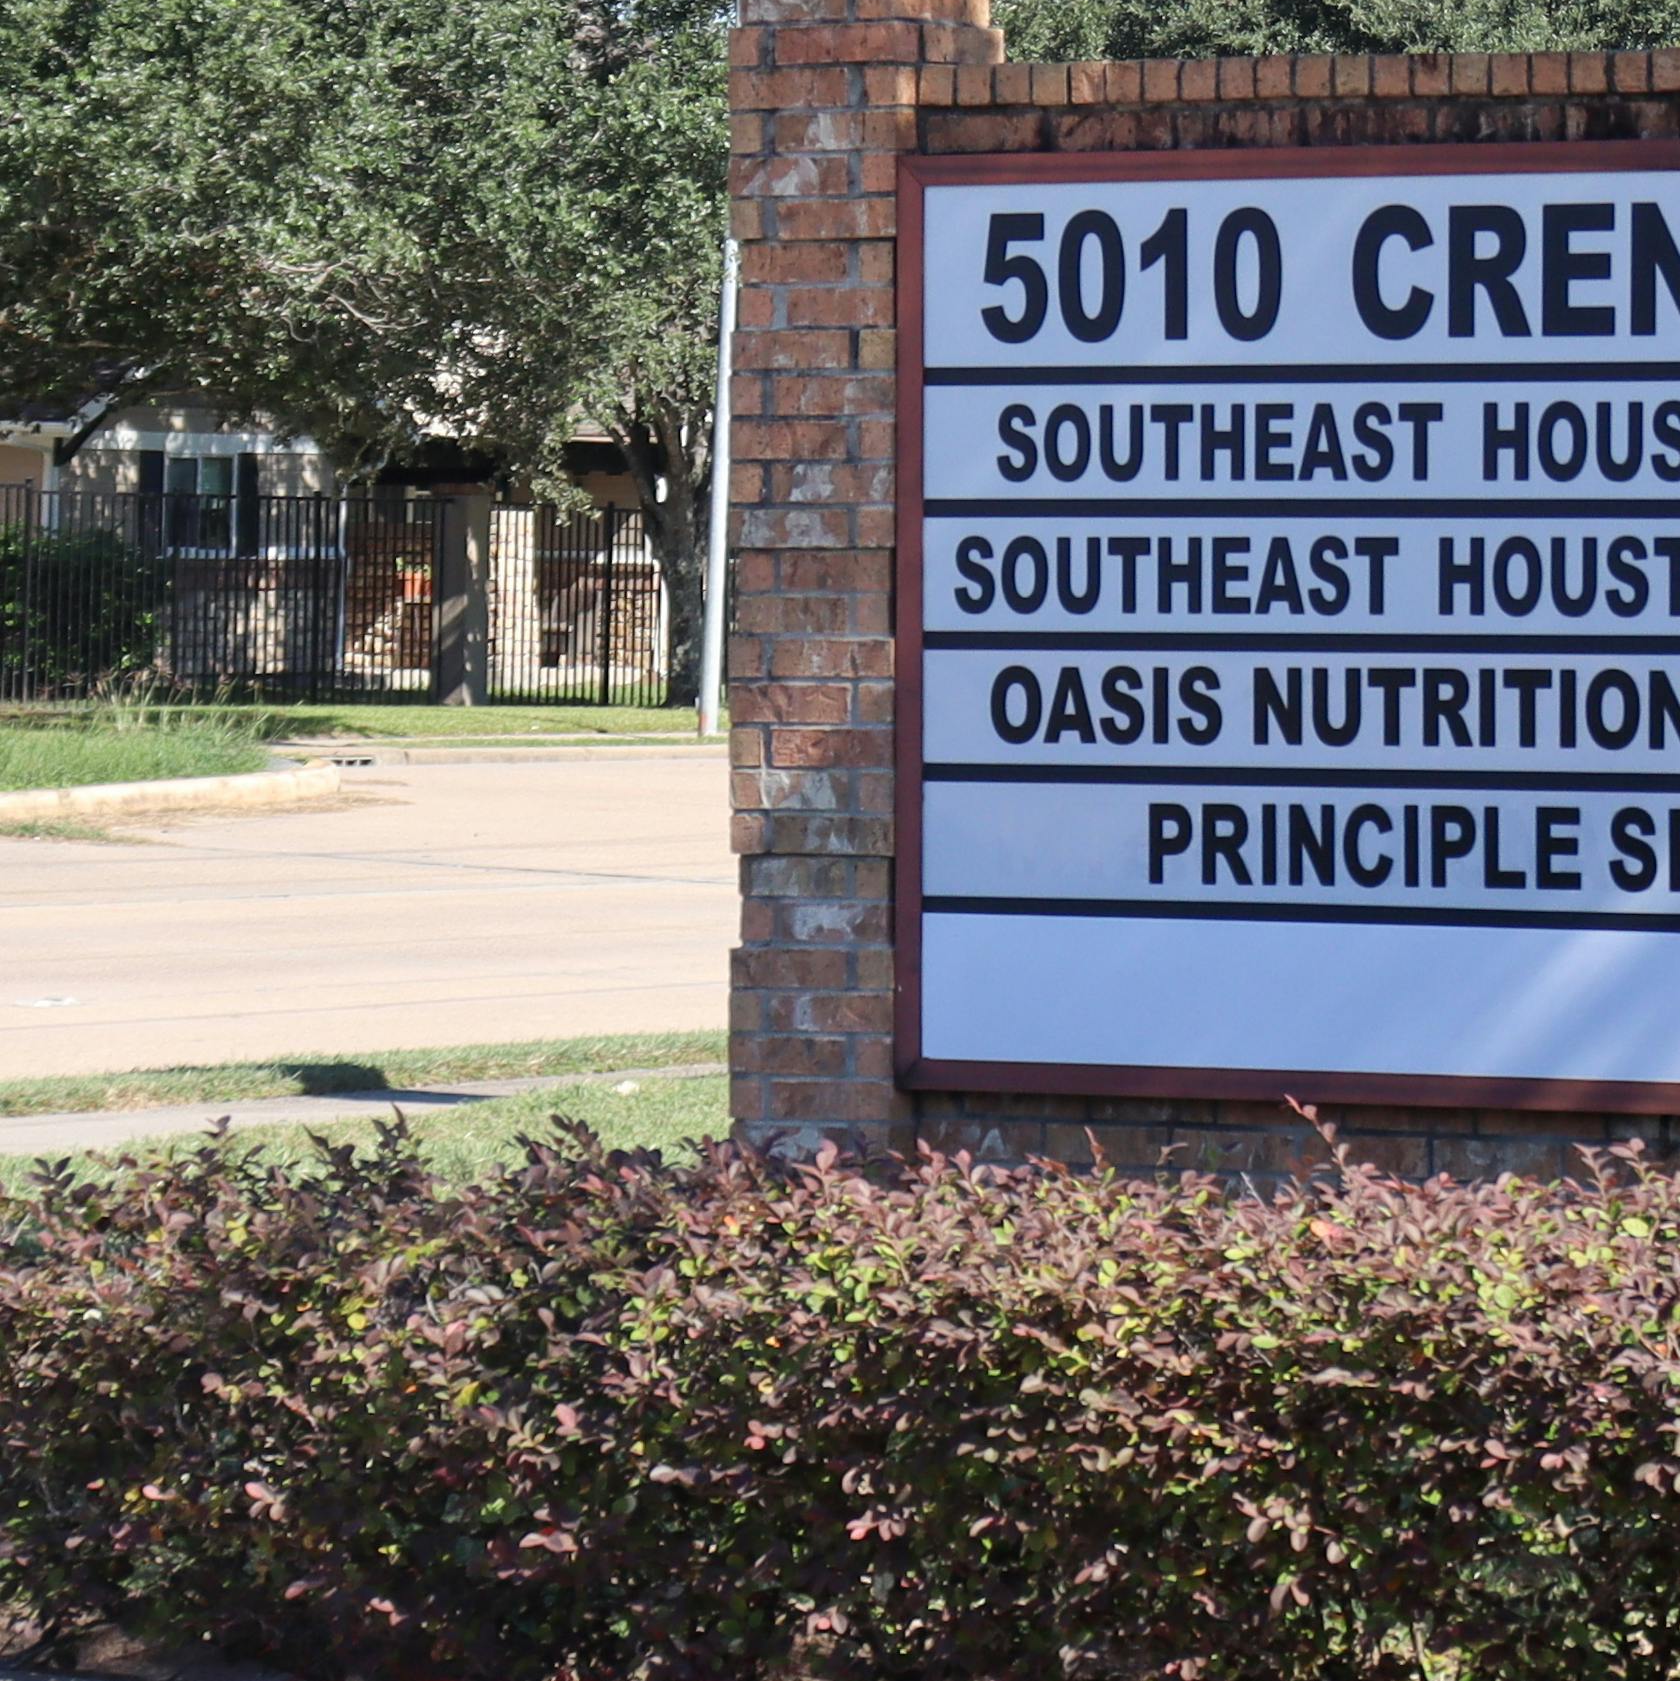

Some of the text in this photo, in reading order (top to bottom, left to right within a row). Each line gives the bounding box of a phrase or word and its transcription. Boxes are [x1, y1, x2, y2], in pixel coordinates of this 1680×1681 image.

[980, 206, 1283, 345] 5010
[996, 401, 1444, 483] SOUTHEAST
[954, 535, 1400, 617] SOUTHEAST
[990, 665, 1223, 747] OASIS
[1148, 802, 1583, 891] PRINCIPLE
